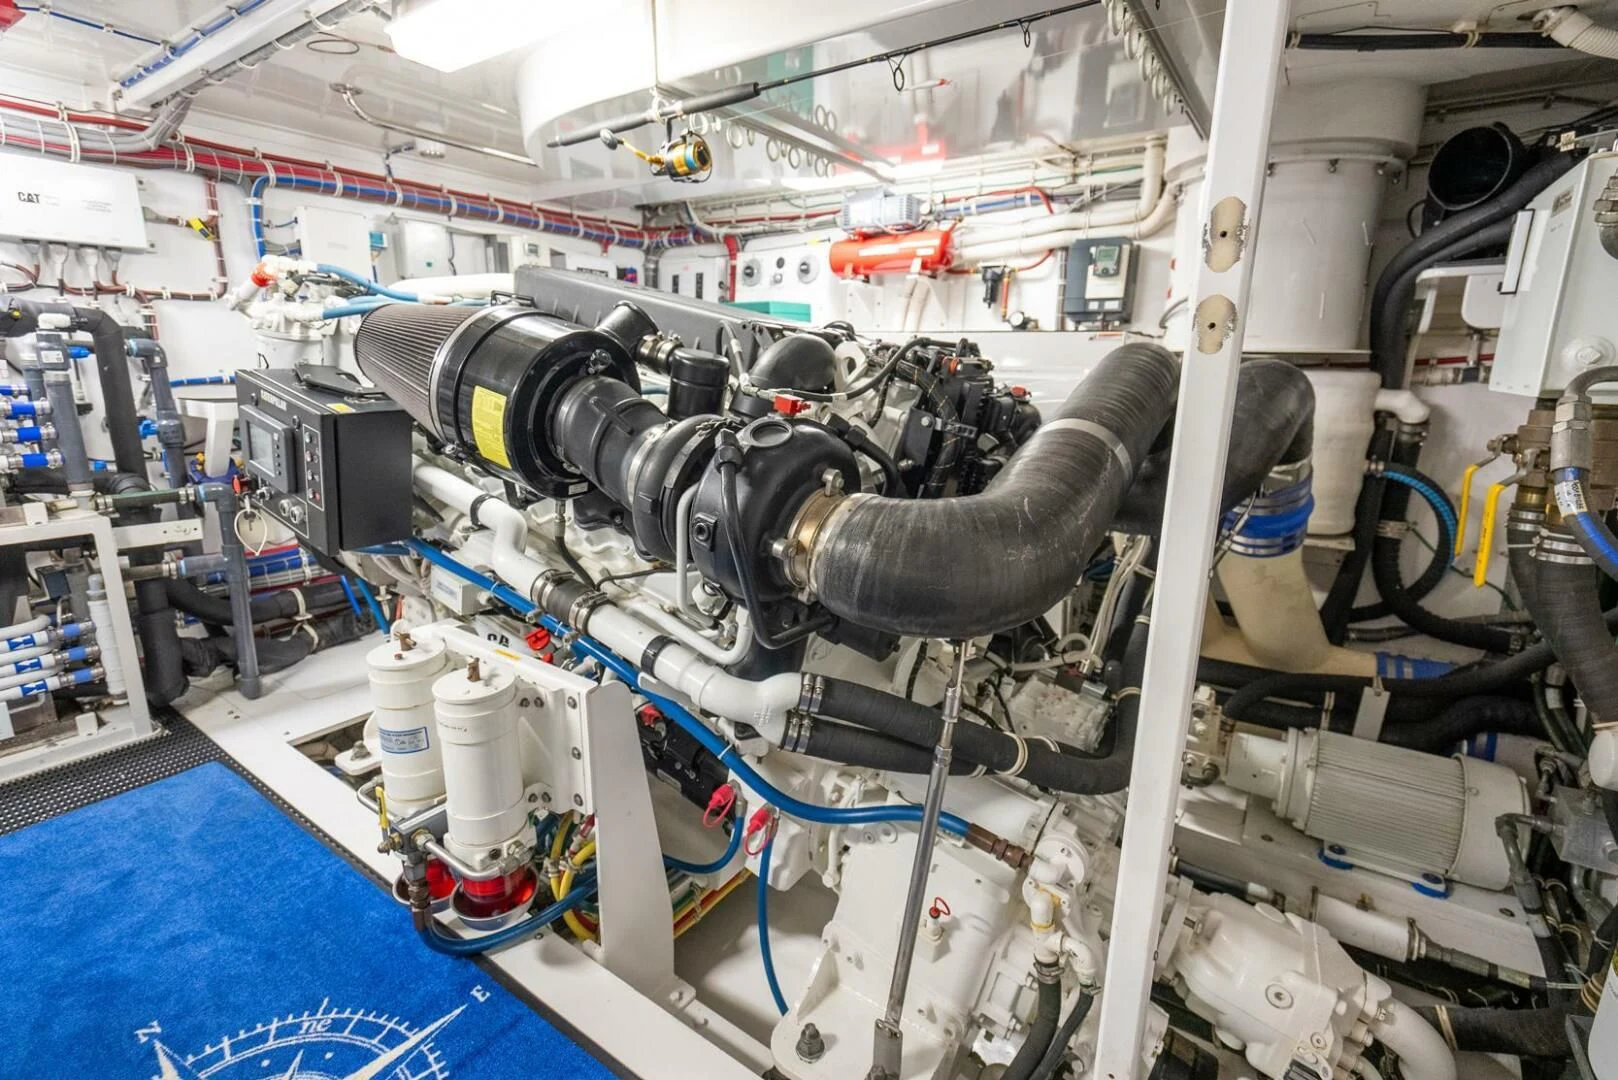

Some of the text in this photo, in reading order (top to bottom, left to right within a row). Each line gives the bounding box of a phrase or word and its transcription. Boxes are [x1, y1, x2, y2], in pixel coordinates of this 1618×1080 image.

[17, 191, 41, 204] CAT
[470, 984, 491, 1002] E
[134, 1019, 162, 1043] N
[299, 1017, 332, 1034] ne
